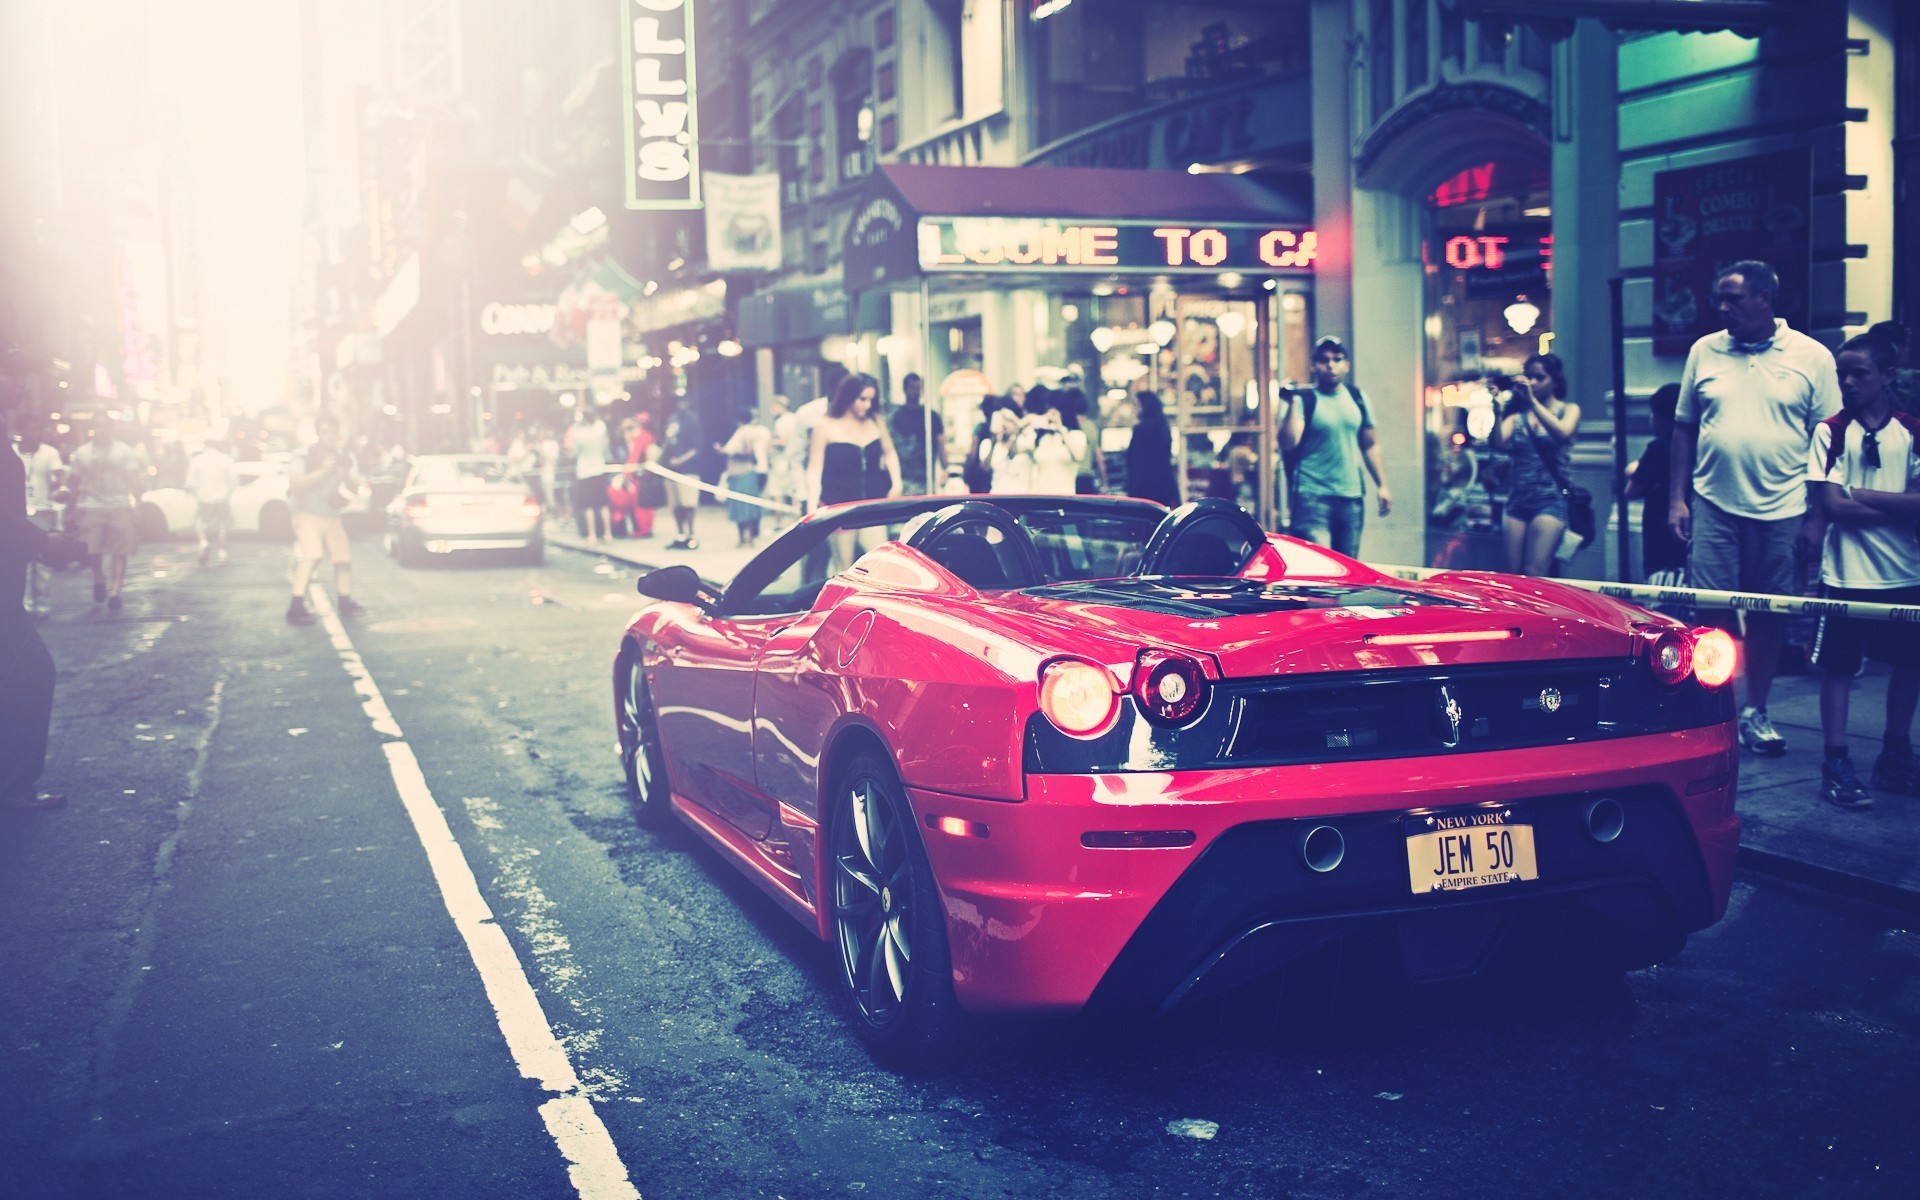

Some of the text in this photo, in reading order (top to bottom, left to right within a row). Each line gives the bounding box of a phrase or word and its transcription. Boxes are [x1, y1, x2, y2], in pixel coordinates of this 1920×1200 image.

[1699, 191, 1760, 217] COMBO
[1153, 228, 1228, 266] TO
[1730, 596, 1771, 612] CAUTION
[1437, 812, 1504, 830] NEW YORK
[1433, 830, 1514, 876] JEM 50
[1441, 871, 1510, 889] EMPIRE STATE
